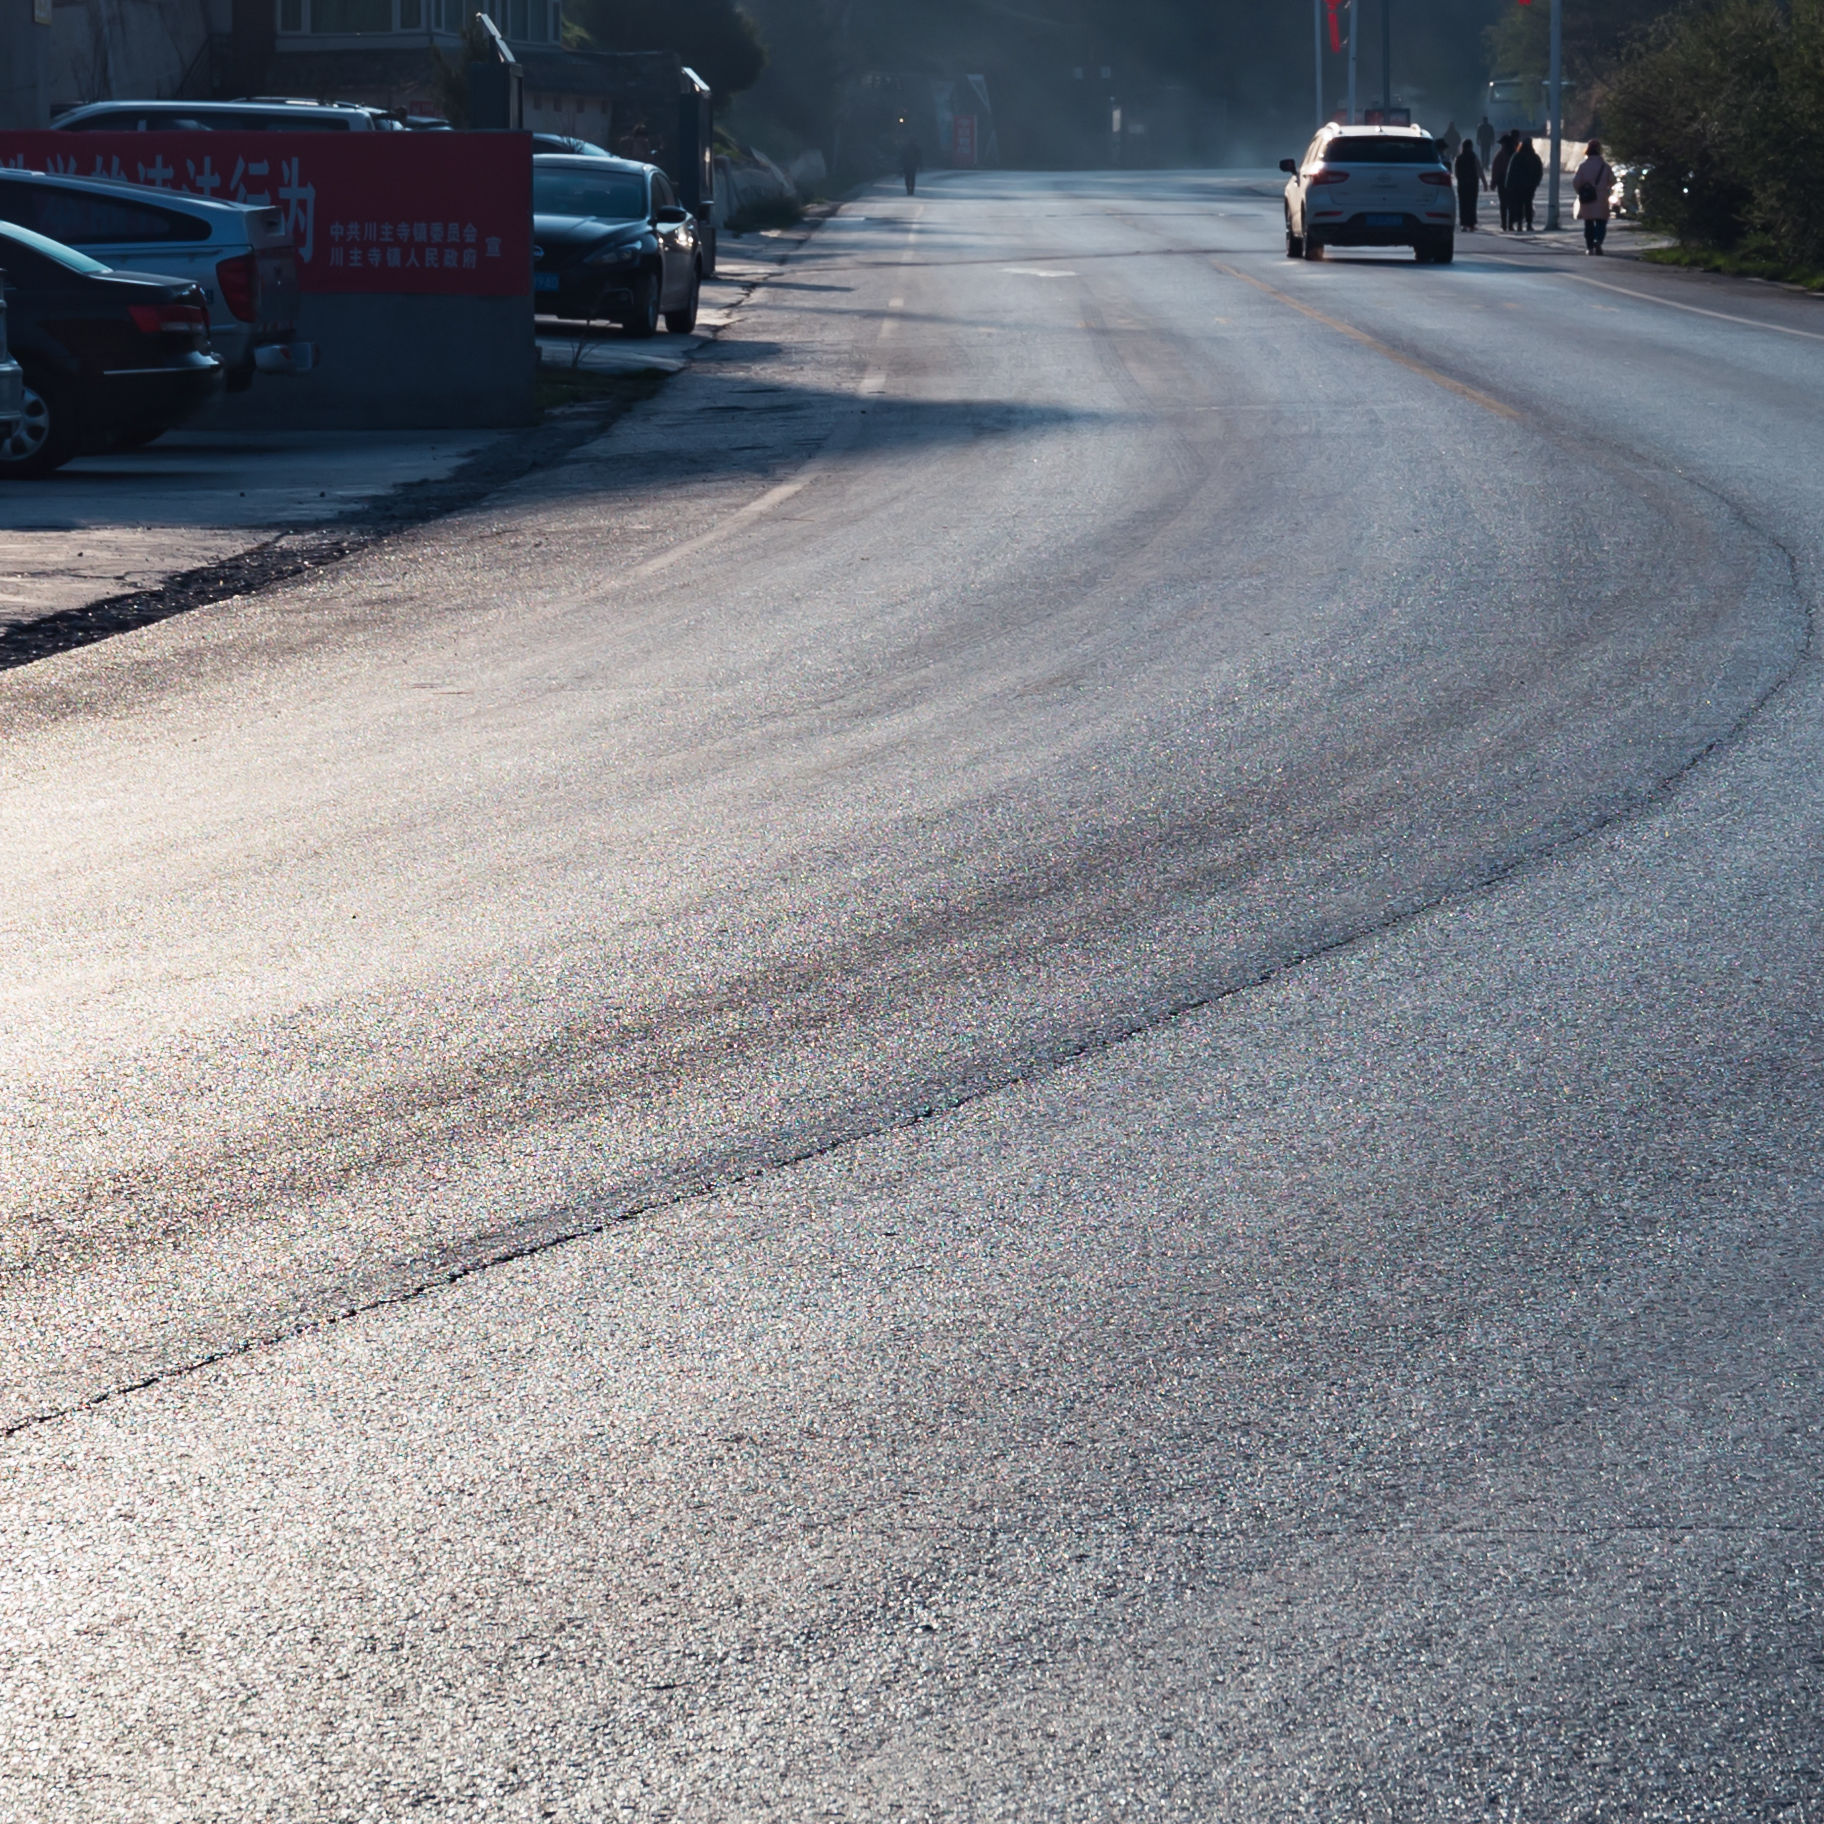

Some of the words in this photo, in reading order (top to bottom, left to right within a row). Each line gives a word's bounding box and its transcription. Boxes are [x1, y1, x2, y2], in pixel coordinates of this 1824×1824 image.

[329, 221, 478, 243] 中共川主寺镇委员会
[329, 246, 478, 269] 川主寺镇人民政府
[484, 236, 503, 257] 宣
